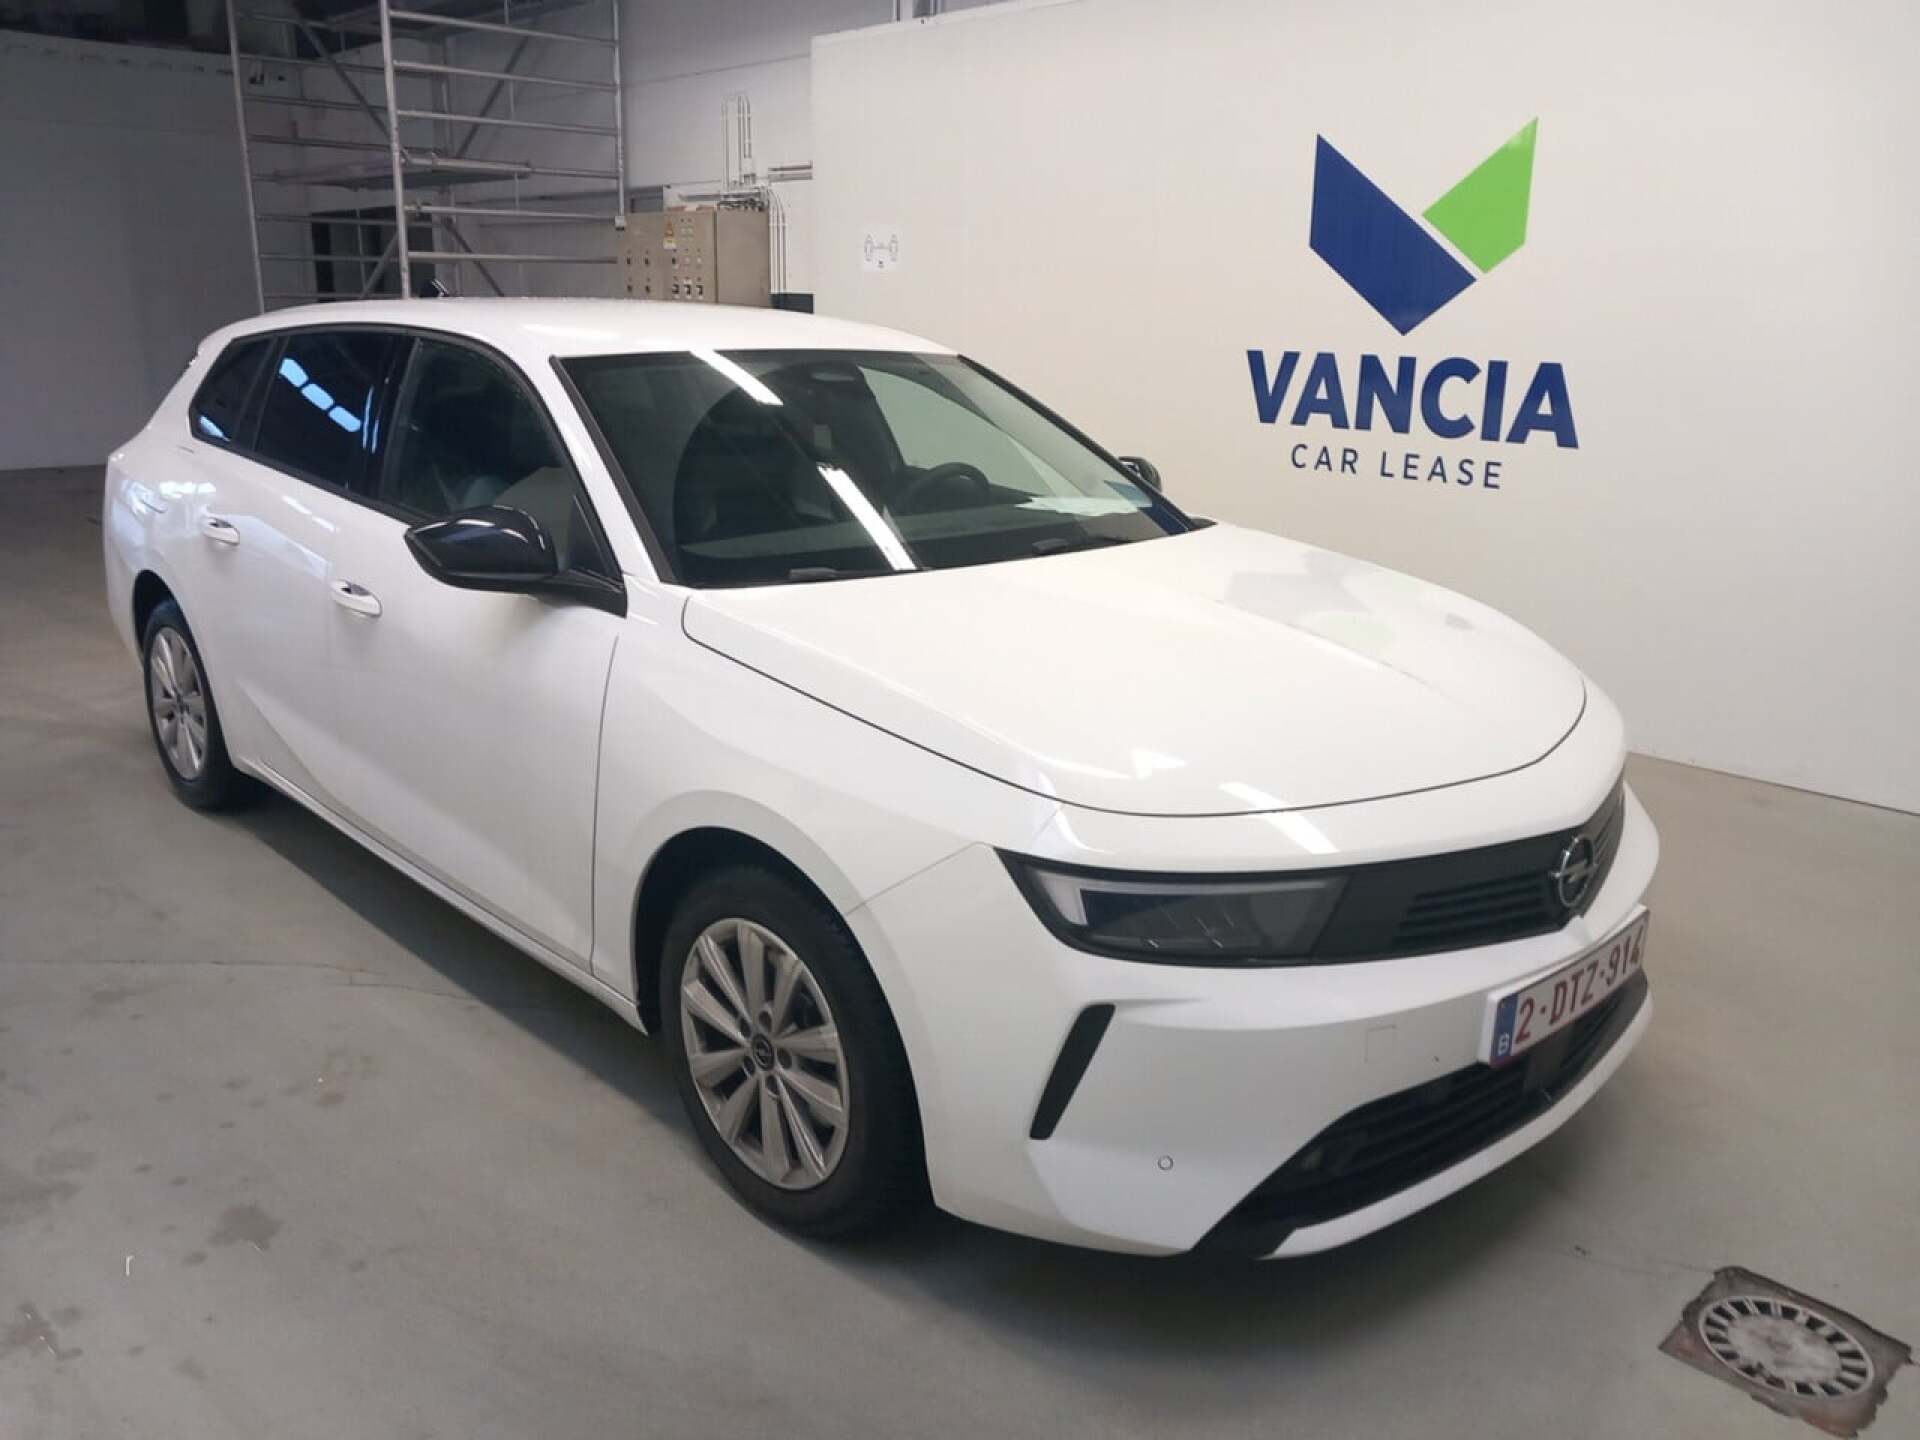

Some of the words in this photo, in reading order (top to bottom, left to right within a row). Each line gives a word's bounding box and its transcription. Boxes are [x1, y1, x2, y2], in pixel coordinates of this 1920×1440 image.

[1246, 349, 1579, 449] VANCIA
[1291, 443, 1359, 474] CAR
[1380, 451, 1502, 489] LEASE
[1498, 1033, 1510, 1056] B
